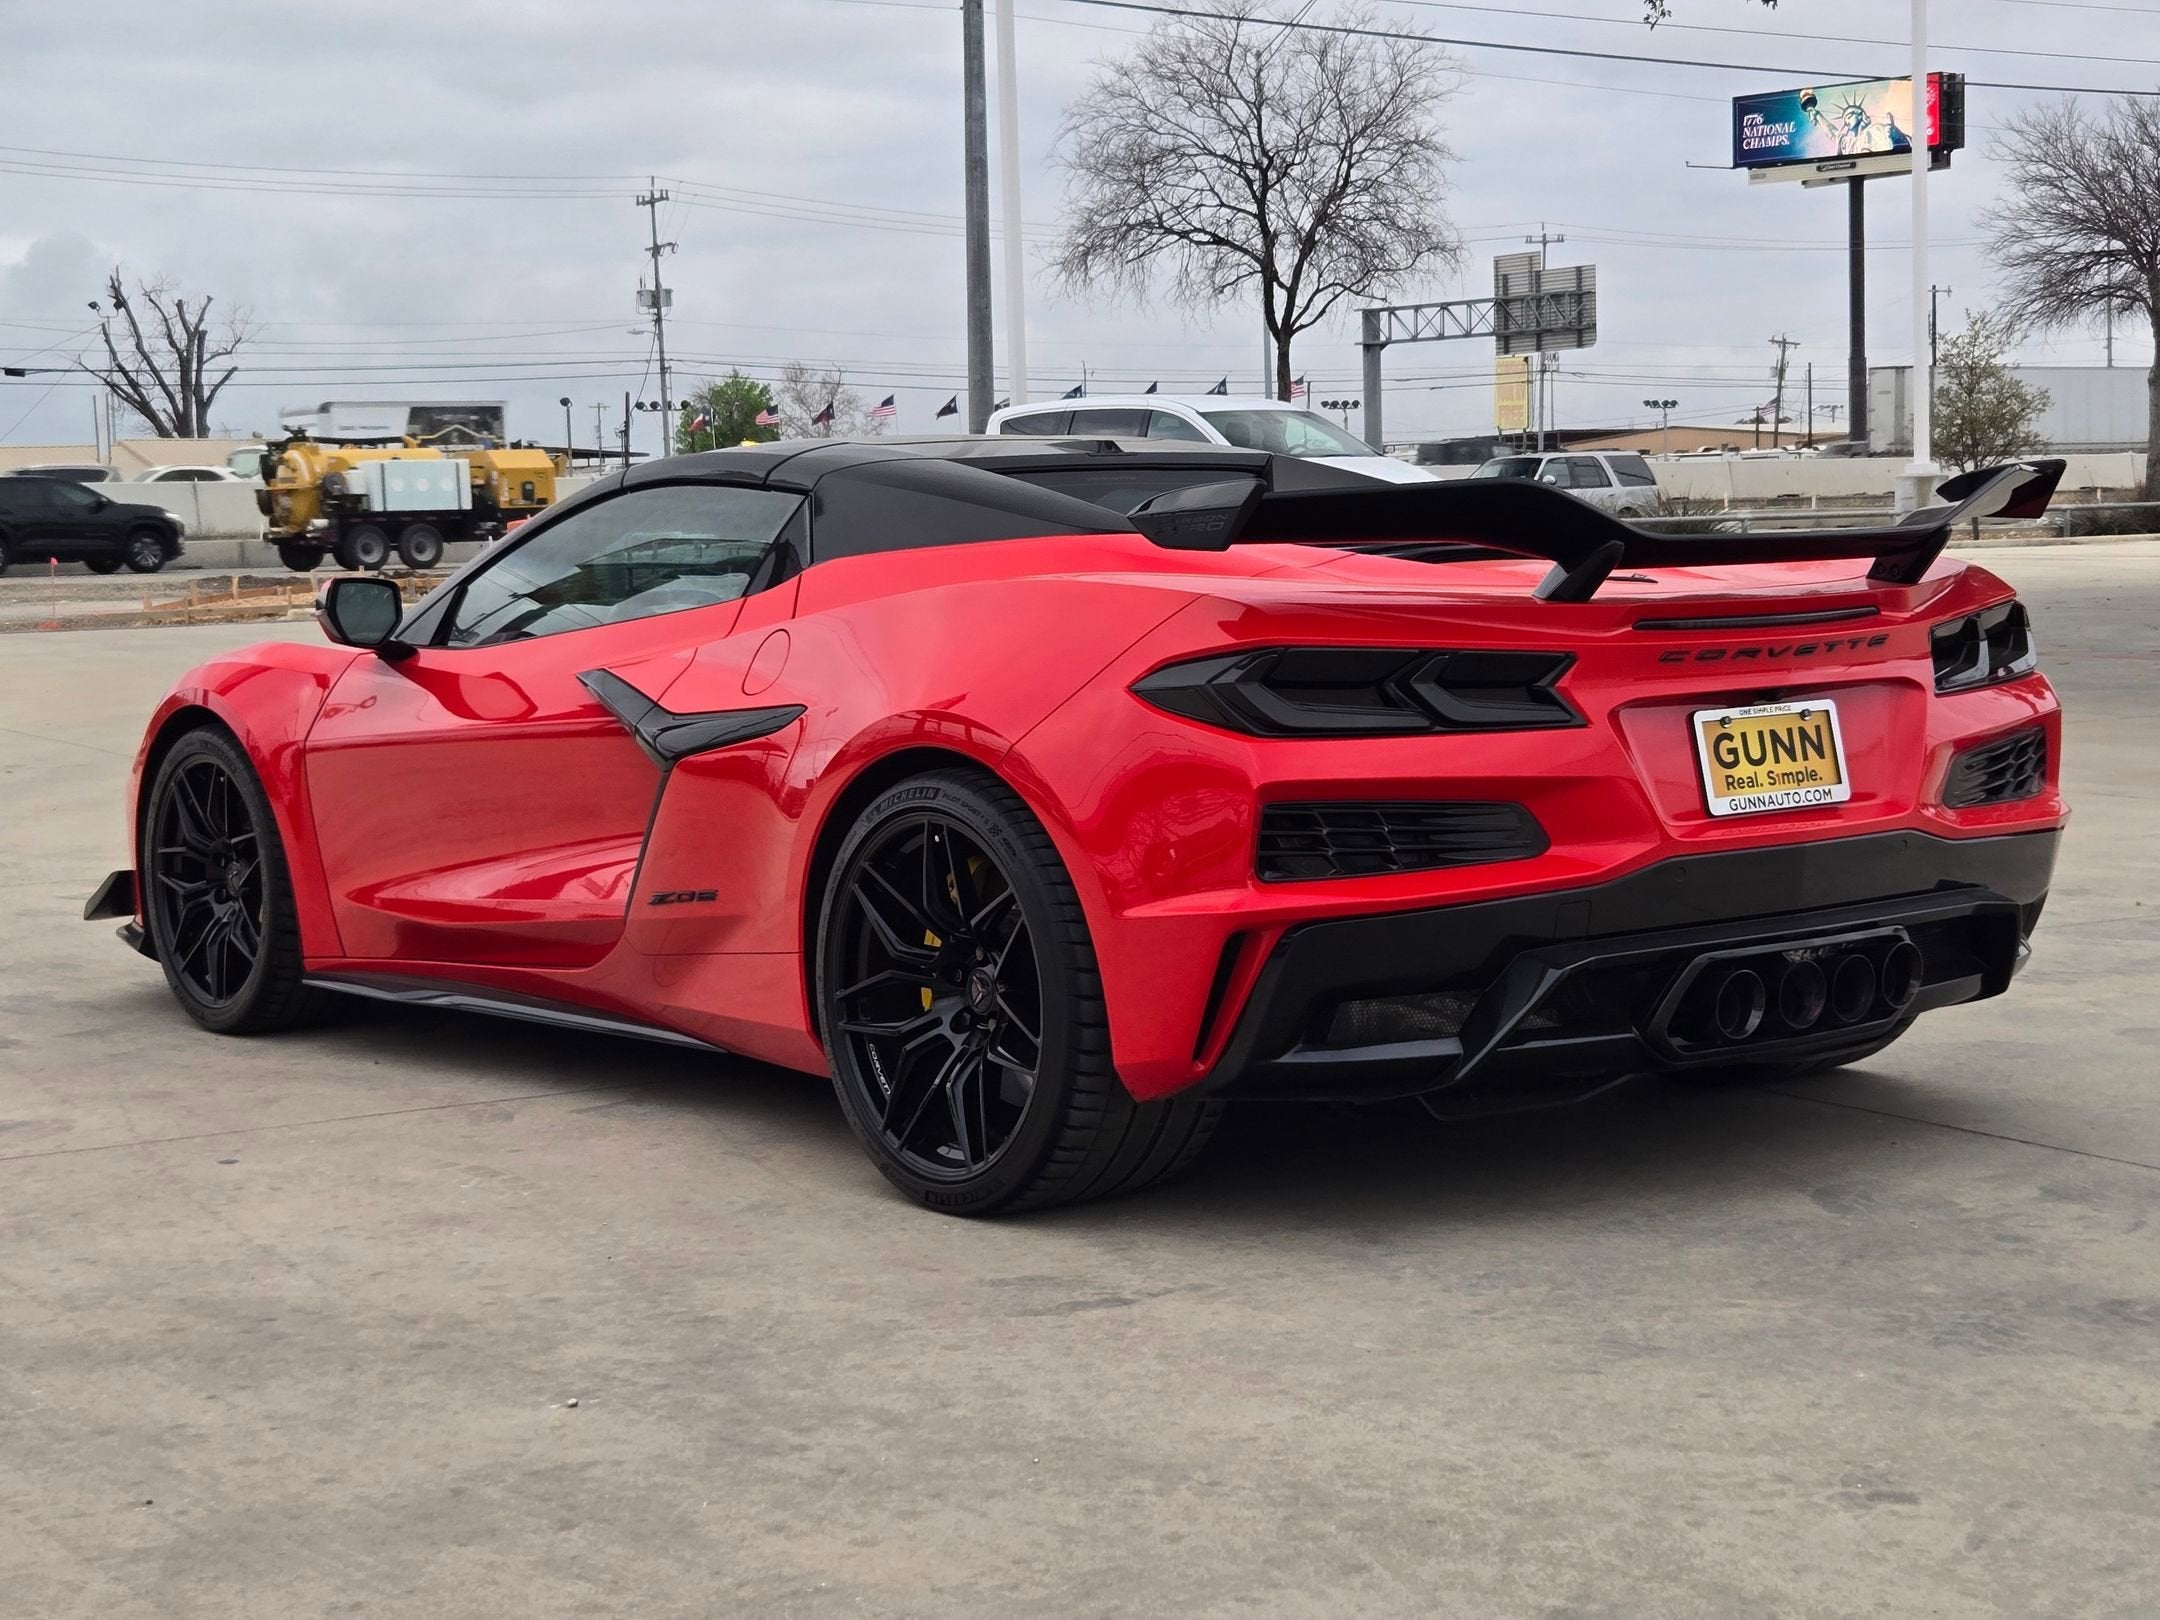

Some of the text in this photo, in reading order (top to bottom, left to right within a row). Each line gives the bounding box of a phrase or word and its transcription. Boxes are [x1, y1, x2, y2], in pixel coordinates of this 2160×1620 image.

[1743, 113, 1763, 126] 1776
[1743, 121, 1795, 138] NATIONAL
[1743, 134, 1790, 150] CHAMPS.
[1658, 633, 1889, 663] CORVETTE
[1713, 724, 1826, 770] GUNN
[1725, 771, 1763, 790] Real.
[879, 788, 936, 811] MICHELIN
[1729, 788, 1833, 811] GUNNAUTO.COM
